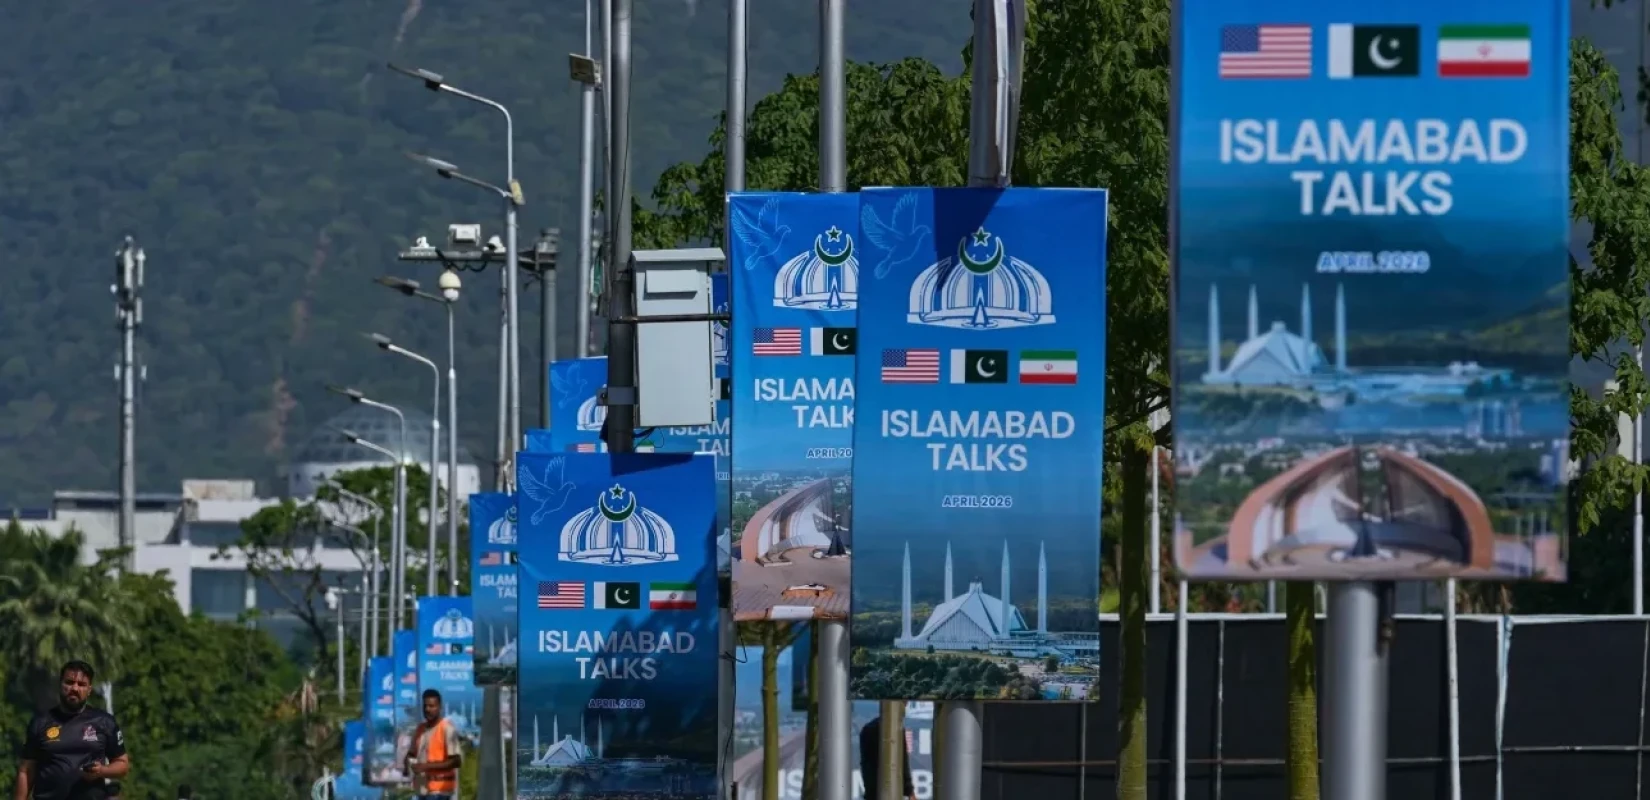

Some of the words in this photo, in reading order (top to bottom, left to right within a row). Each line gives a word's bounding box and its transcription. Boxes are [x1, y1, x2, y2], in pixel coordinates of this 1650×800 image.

[1219, 118, 1528, 165] ISLAMABAD
[1290, 171, 1454, 216] TALKS
[754, 378, 855, 401] ISLAMA
[792, 405, 855, 428] TALK
[881, 410, 1075, 439] ISLAMABAD
[806, 448, 837, 459] APRIL
[838, 447, 853, 459] 20
[926, 443, 1028, 472] TALKS
[942, 495, 979, 508] APRIL
[980, 495, 1013, 509] 2026
[480, 573, 518, 587] ISLAM
[496, 586, 518, 599] TAL
[538, 630, 695, 654] ISLAMABAD
[575, 657, 658, 680] TALKS
[588, 699, 618, 709] APRIL
